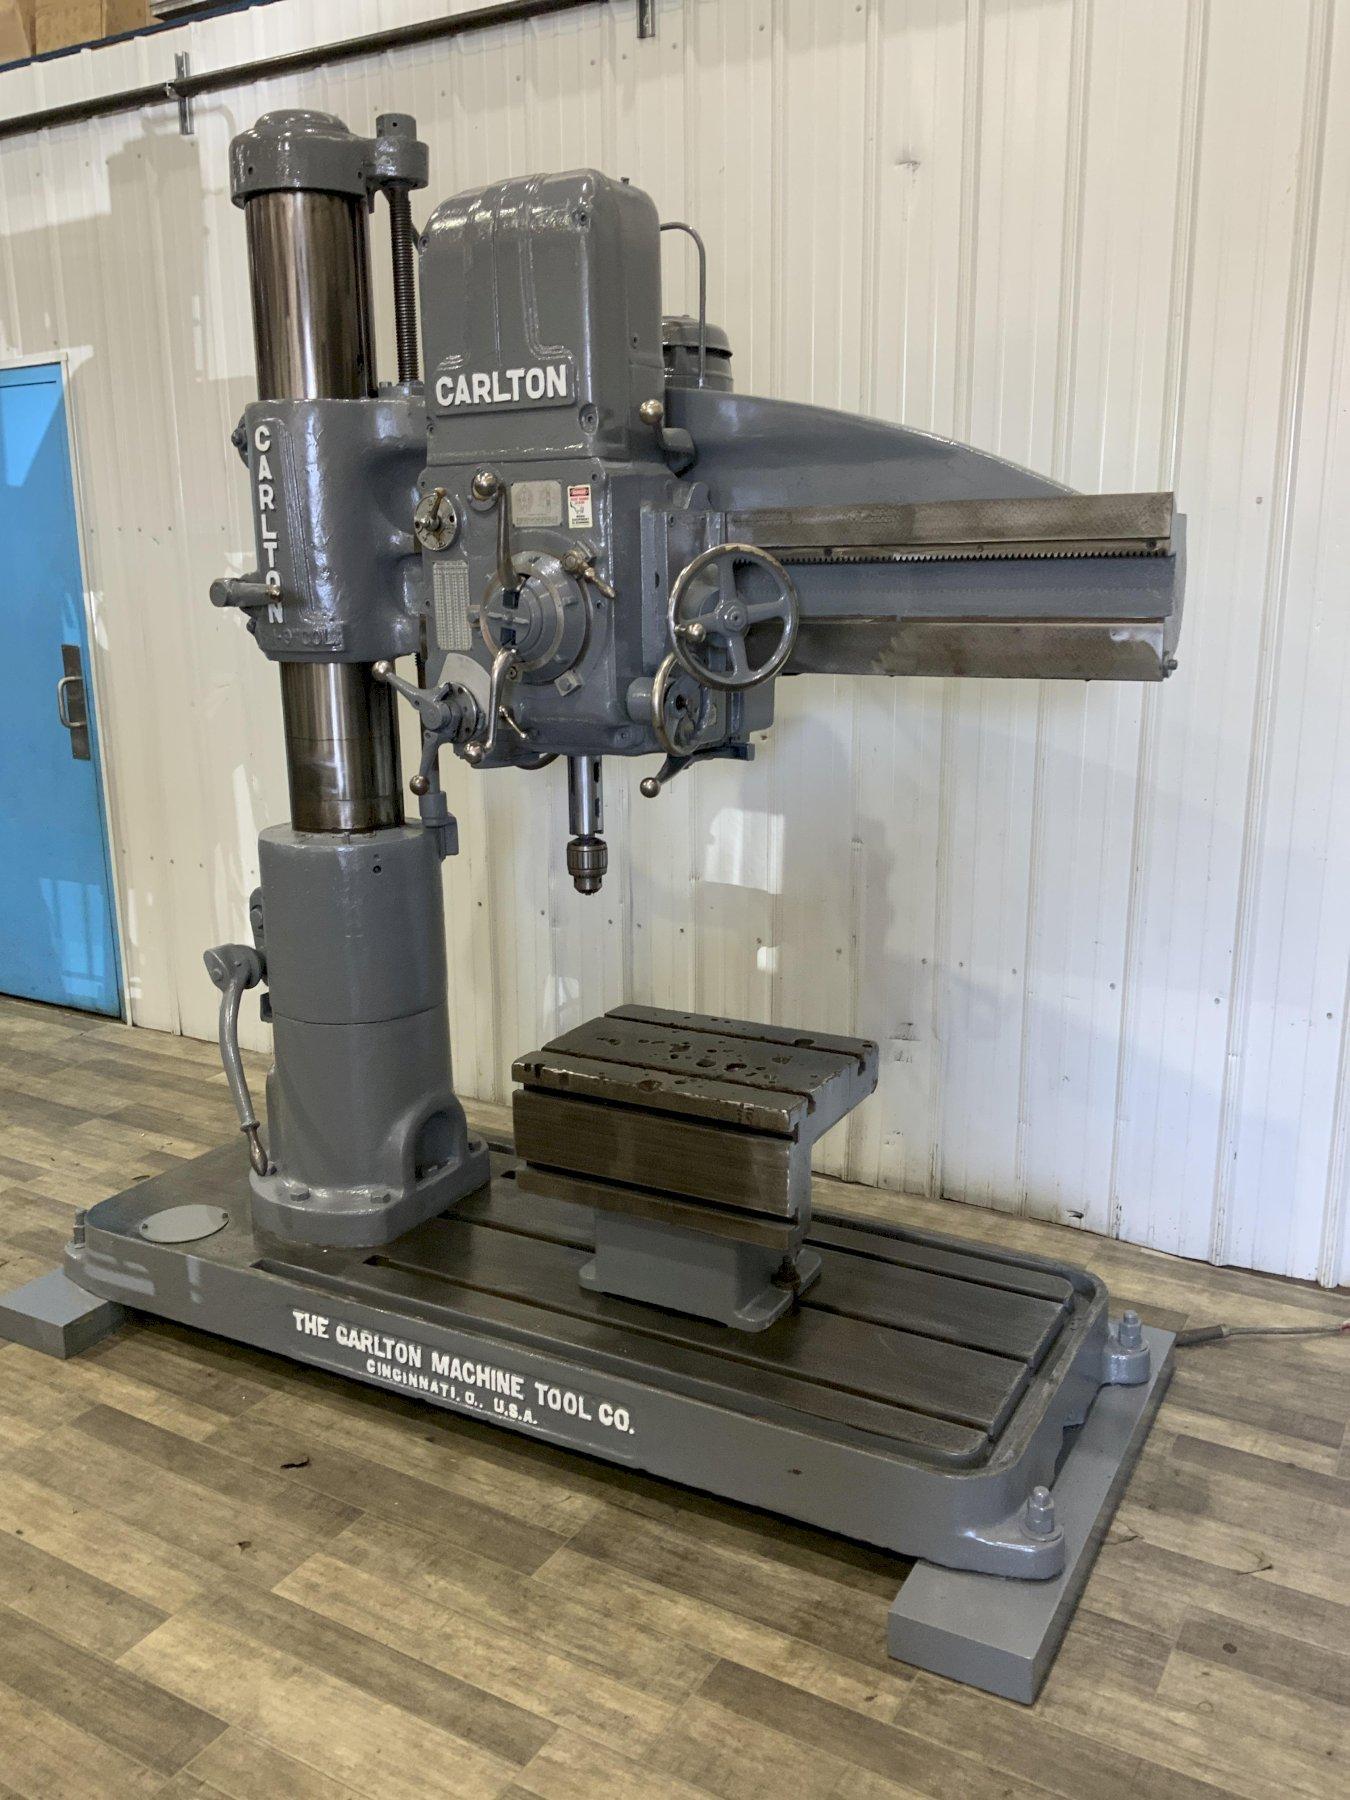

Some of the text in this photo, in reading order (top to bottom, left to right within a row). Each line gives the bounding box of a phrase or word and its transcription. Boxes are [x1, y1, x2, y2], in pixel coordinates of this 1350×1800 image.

[435, 364, 567, 407] CARLTON
[292, 1309, 330, 1339] THE
[431, 1351, 525, 1400] MACHINE
[534, 1381, 592, 1421] TOOL
[598, 1403, 635, 1435] CO.
[493, 1398, 538, 1425] U.S.A.
